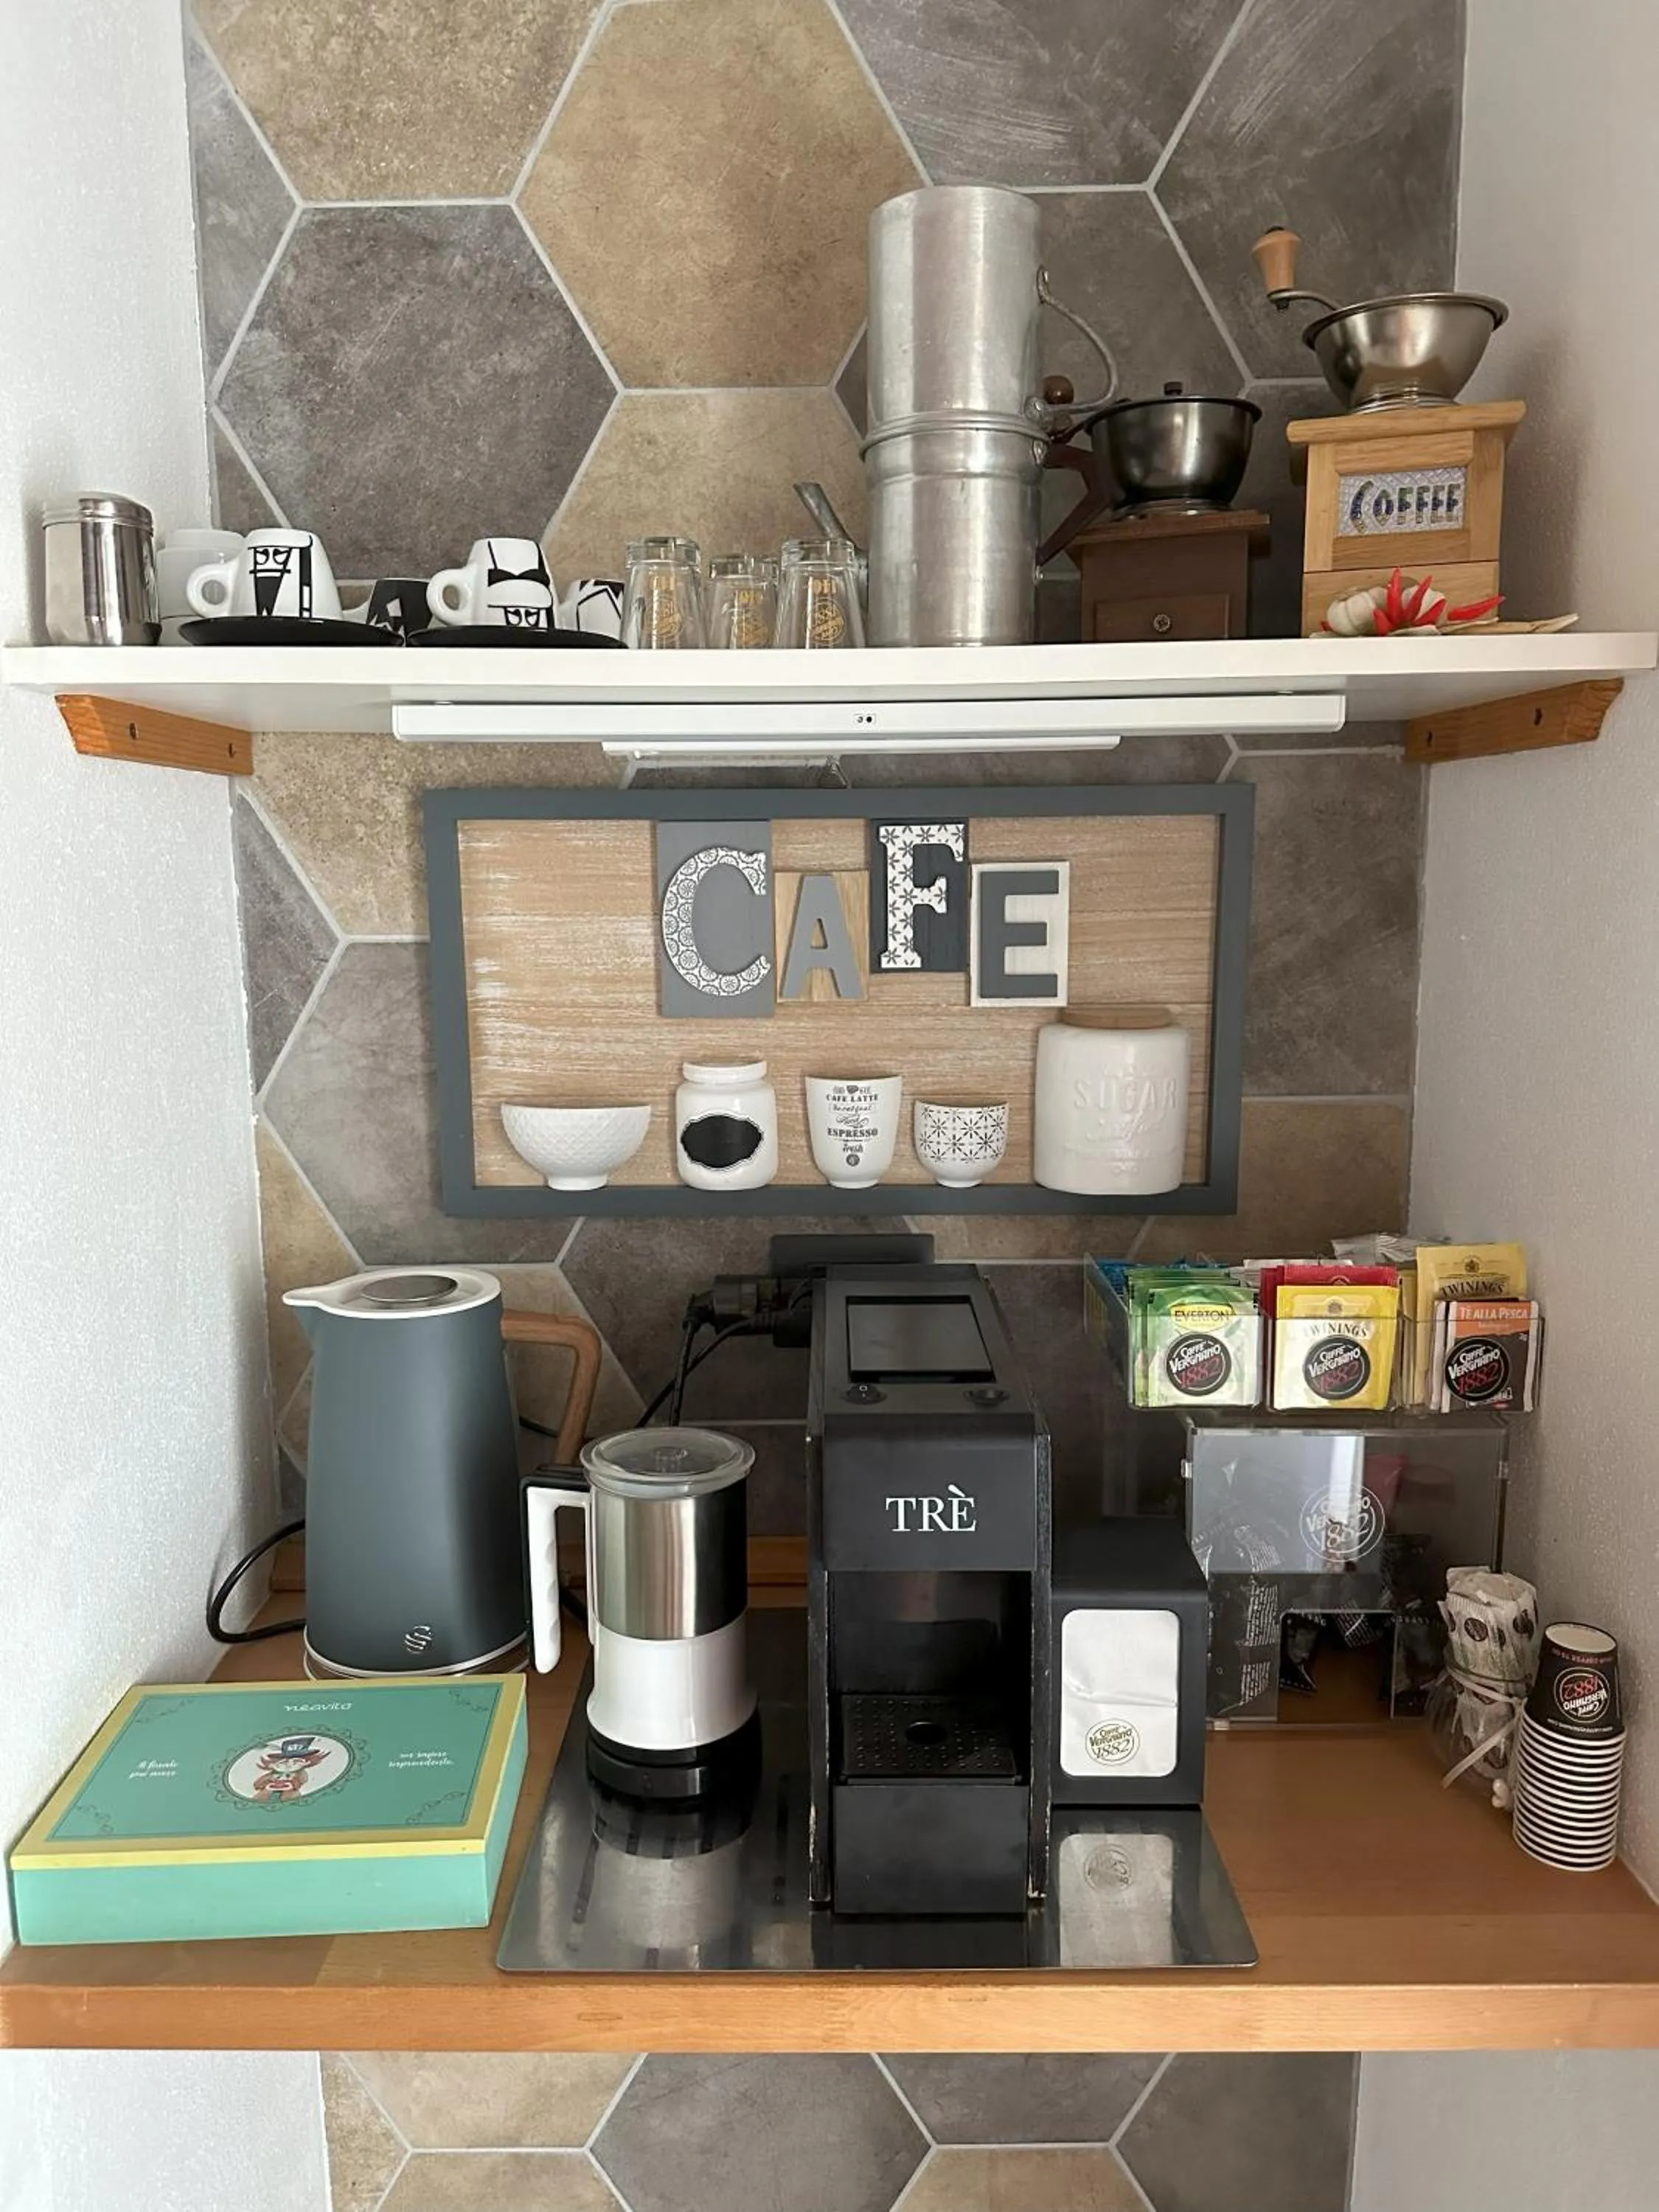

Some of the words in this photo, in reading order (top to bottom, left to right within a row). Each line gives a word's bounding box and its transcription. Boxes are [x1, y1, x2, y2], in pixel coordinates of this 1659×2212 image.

[1350, 480, 1461, 534] COFFEE
[662, 824, 1060, 998] CAFE
[850, 1093, 878, 1102] LATTE
[1074, 1077, 1177, 1113] SUGAR
[827, 1127, 879, 1138] ESPRESSO
[1439, 1280, 1505, 1297] TWININGS
[1174, 1310, 1229, 1322] EVERTON
[1180, 1356, 1221, 1388] 1882
[1320, 1362, 1360, 1392] 1882
[1458, 1363, 1500, 1394] 1882
[886, 1484, 976, 1531] TRÈ
[1563, 1675, 1599, 1700] 1882
